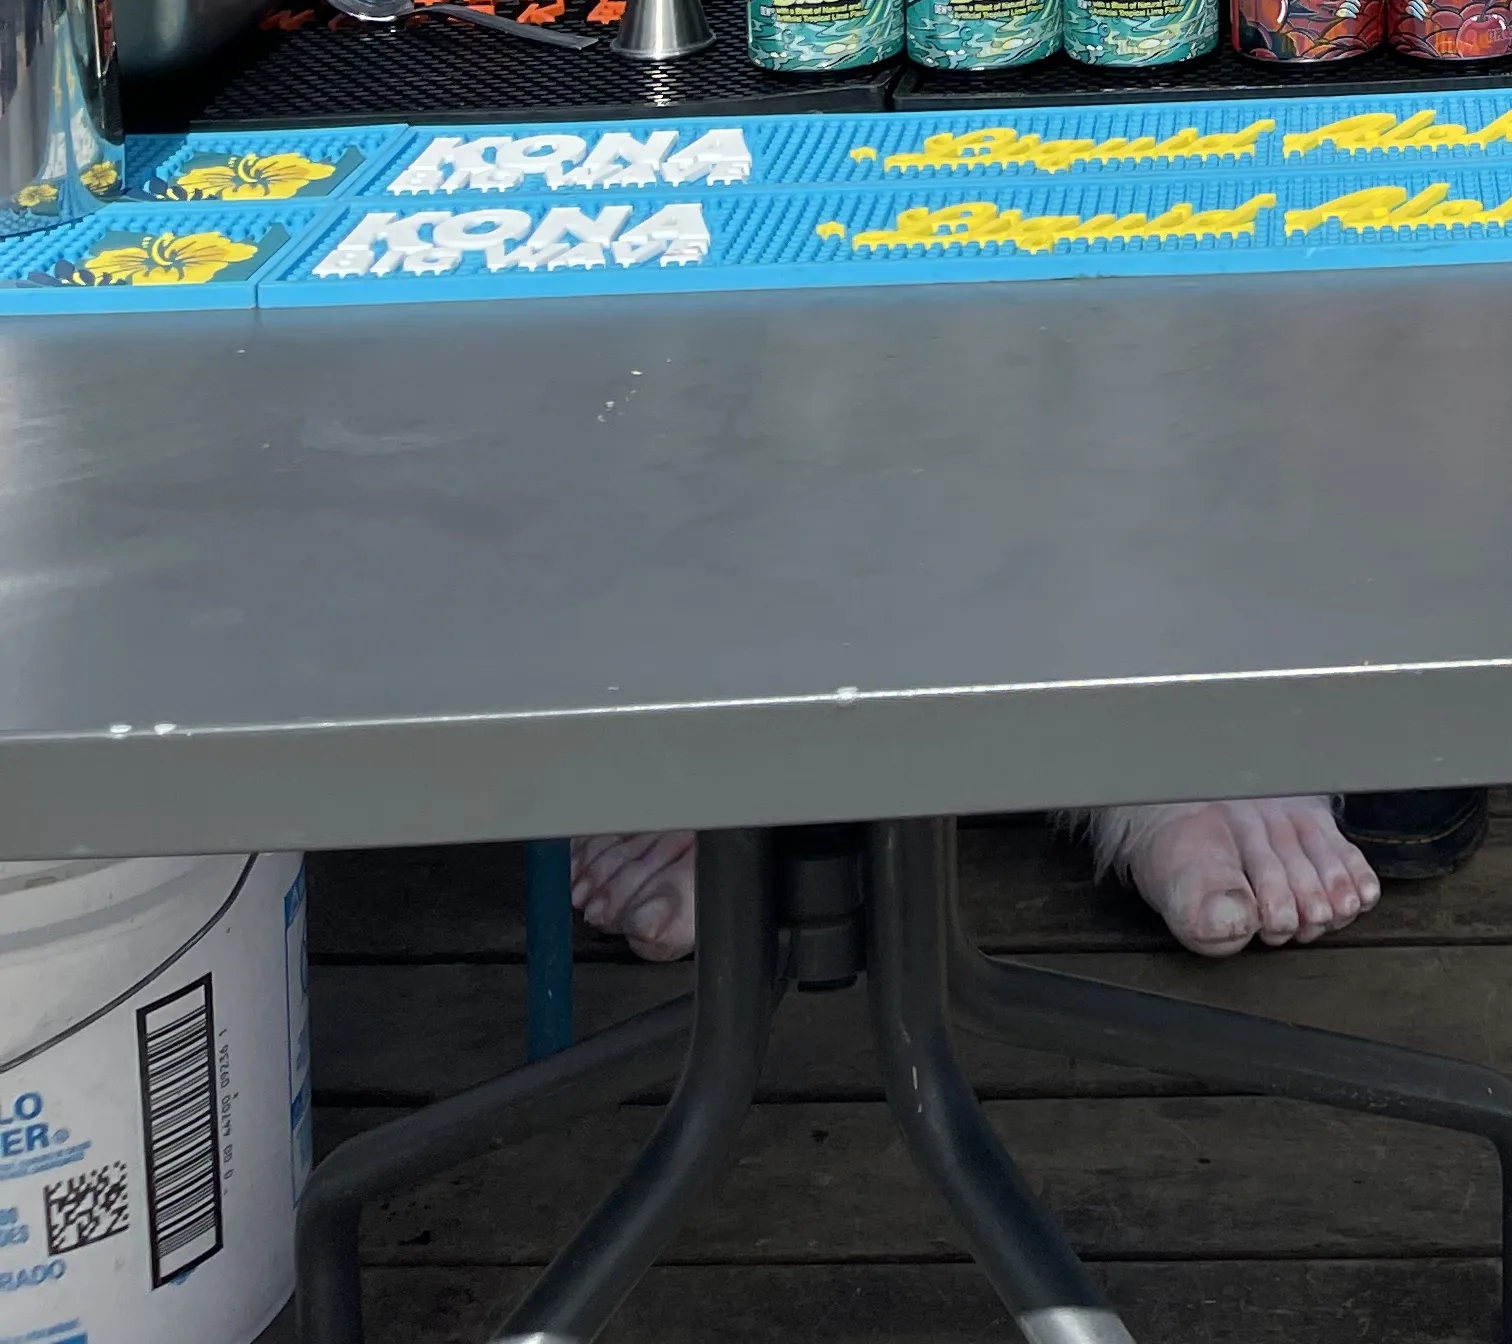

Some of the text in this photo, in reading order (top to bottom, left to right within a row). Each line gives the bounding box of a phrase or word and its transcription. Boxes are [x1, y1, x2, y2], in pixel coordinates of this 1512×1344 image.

[407, 128, 751, 174] KONA
[387, 159, 751, 196] BIG WAVE
[337, 202, 710, 250] KONA
[312, 236, 709, 280] BIG WAVE
